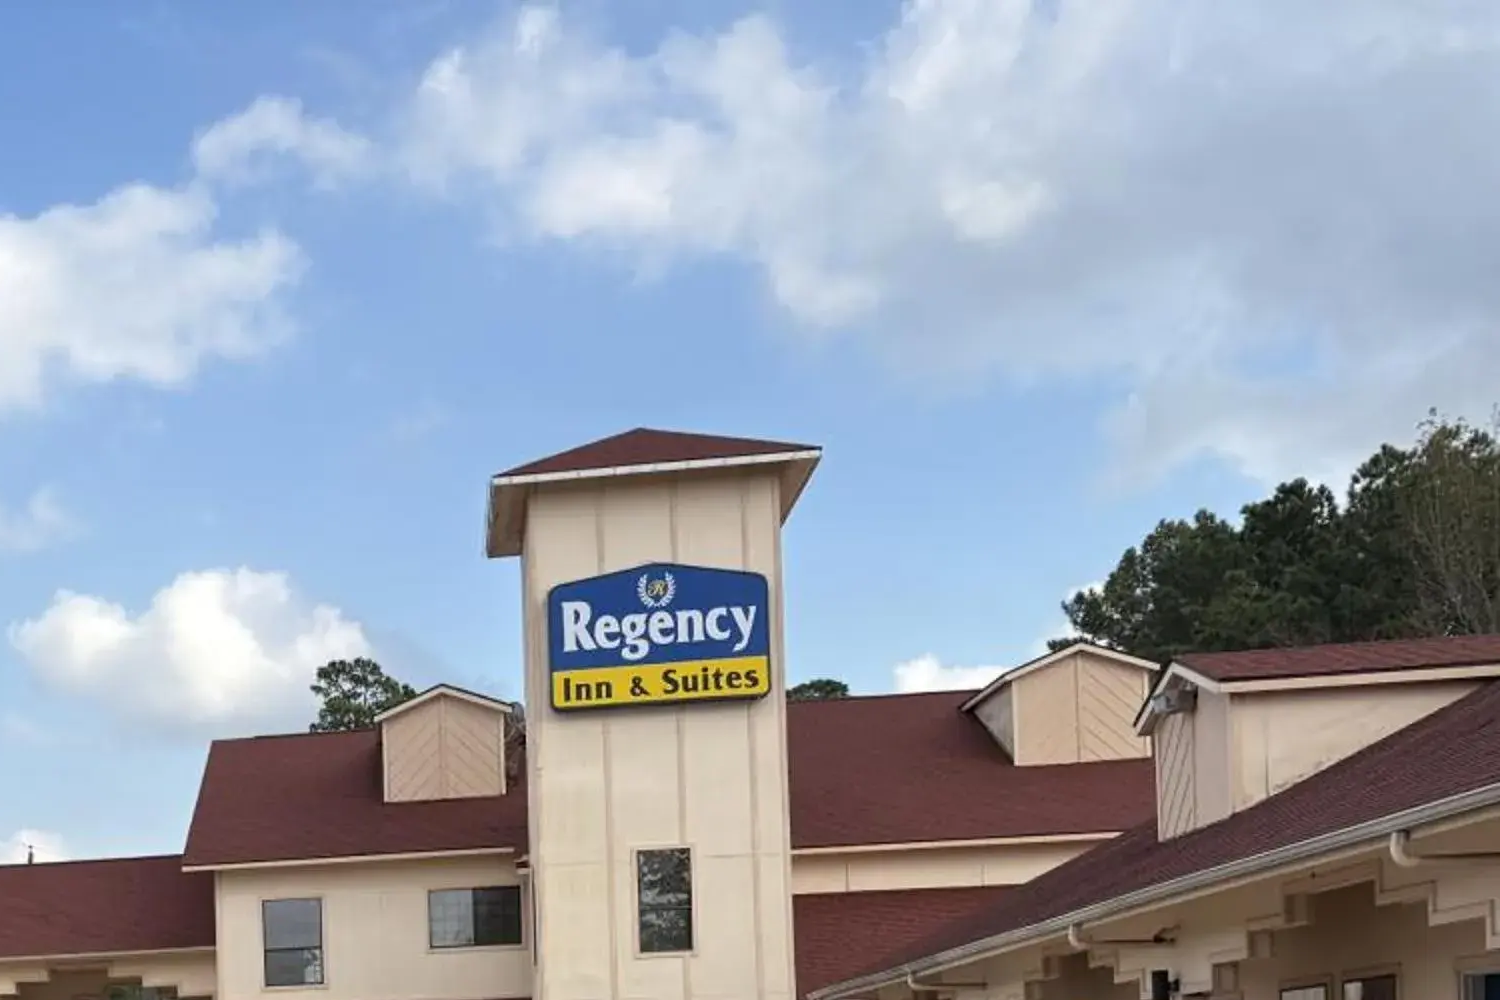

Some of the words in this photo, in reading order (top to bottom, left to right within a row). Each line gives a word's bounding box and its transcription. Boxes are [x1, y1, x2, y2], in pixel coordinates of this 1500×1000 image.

[560, 601, 757, 661] Regency
[563, 677, 613, 703] Inn
[629, 676, 651, 697] &
[662, 667, 759, 694] Suites
